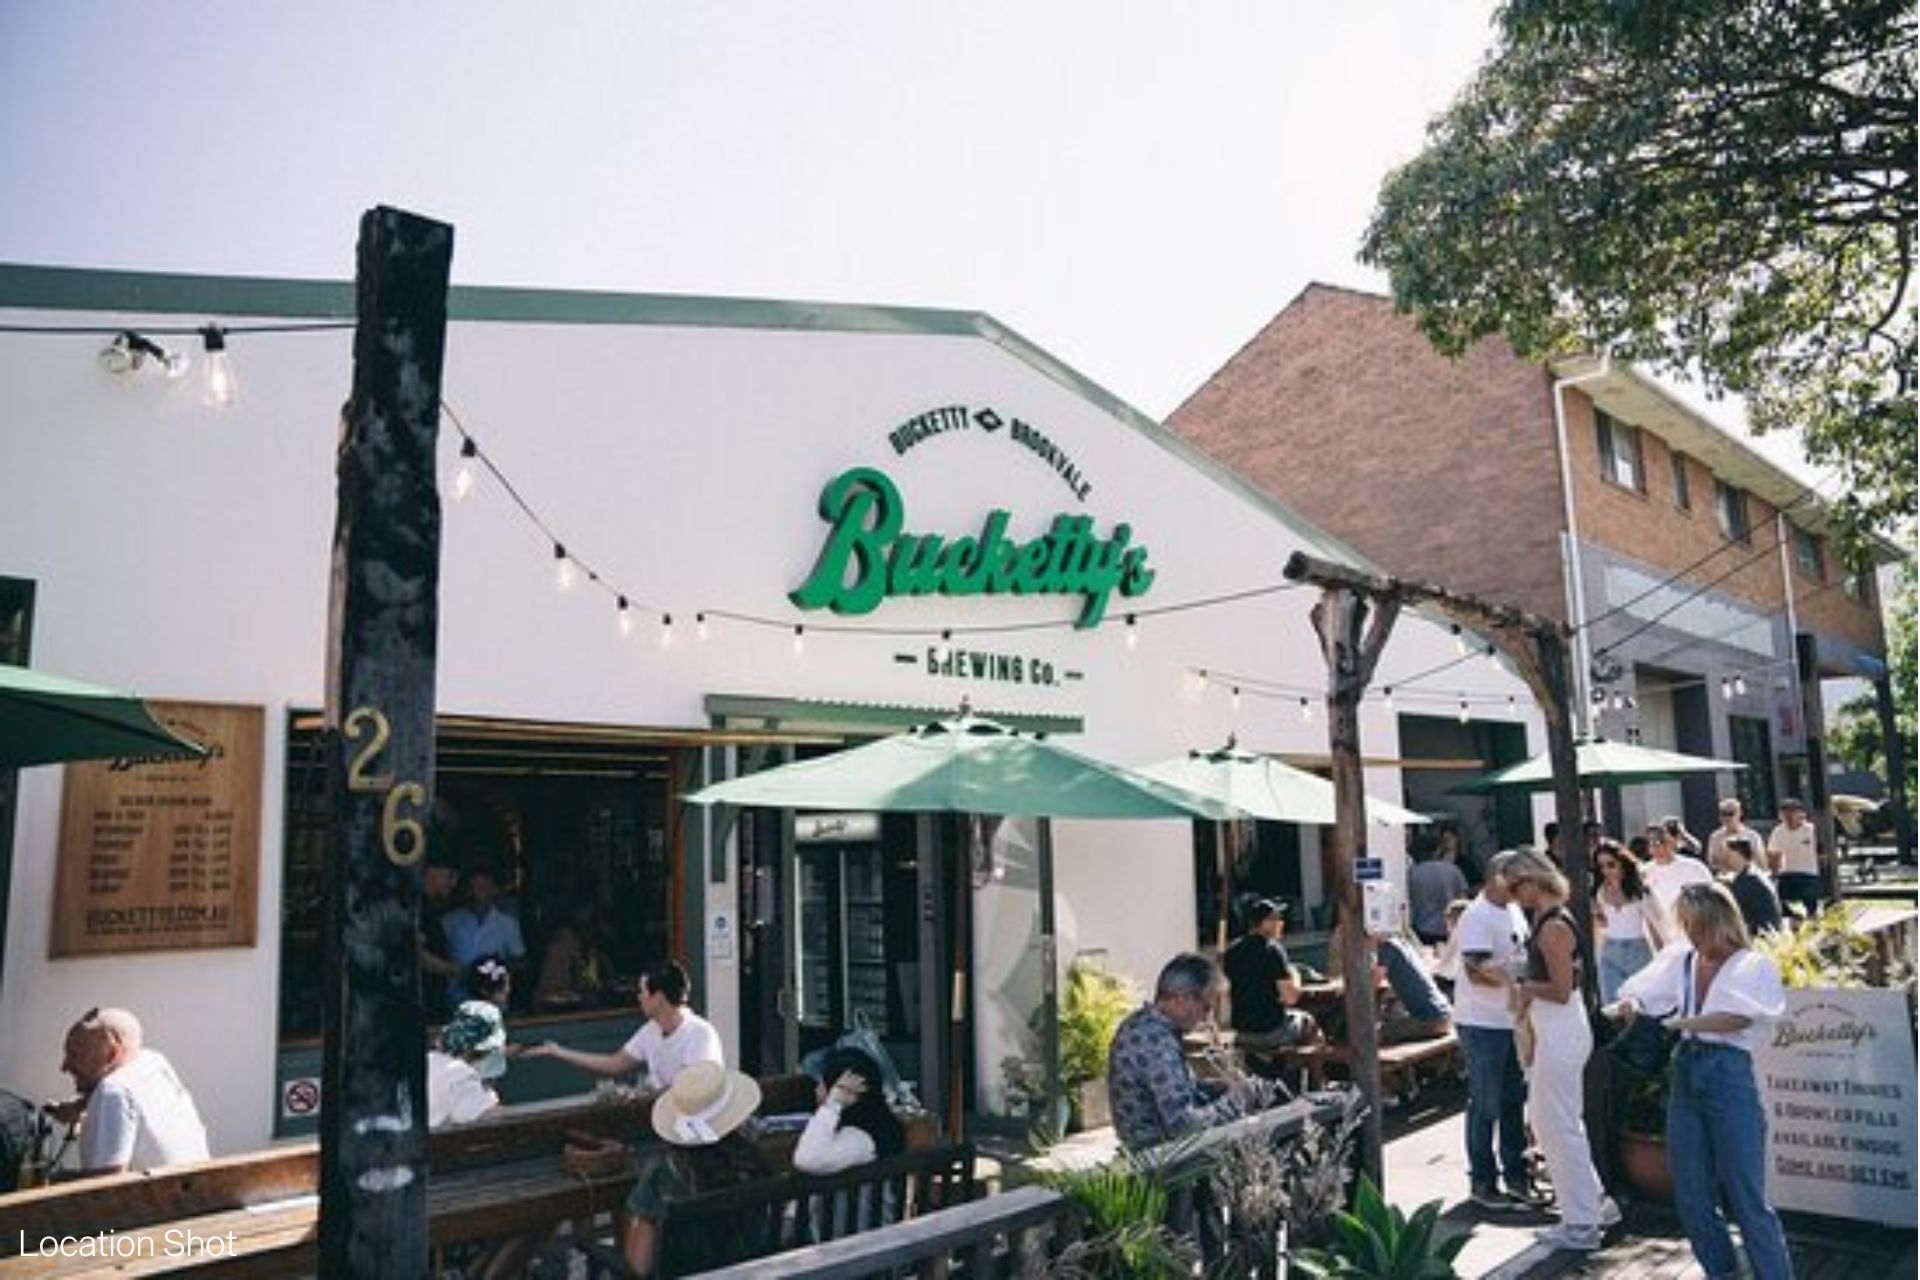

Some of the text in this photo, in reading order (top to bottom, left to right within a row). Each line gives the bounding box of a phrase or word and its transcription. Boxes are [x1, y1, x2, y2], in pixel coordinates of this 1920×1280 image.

[889, 406, 1092, 502] BUCKETTY BROOKVALE
[787, 467, 1154, 630] Bucketty's
